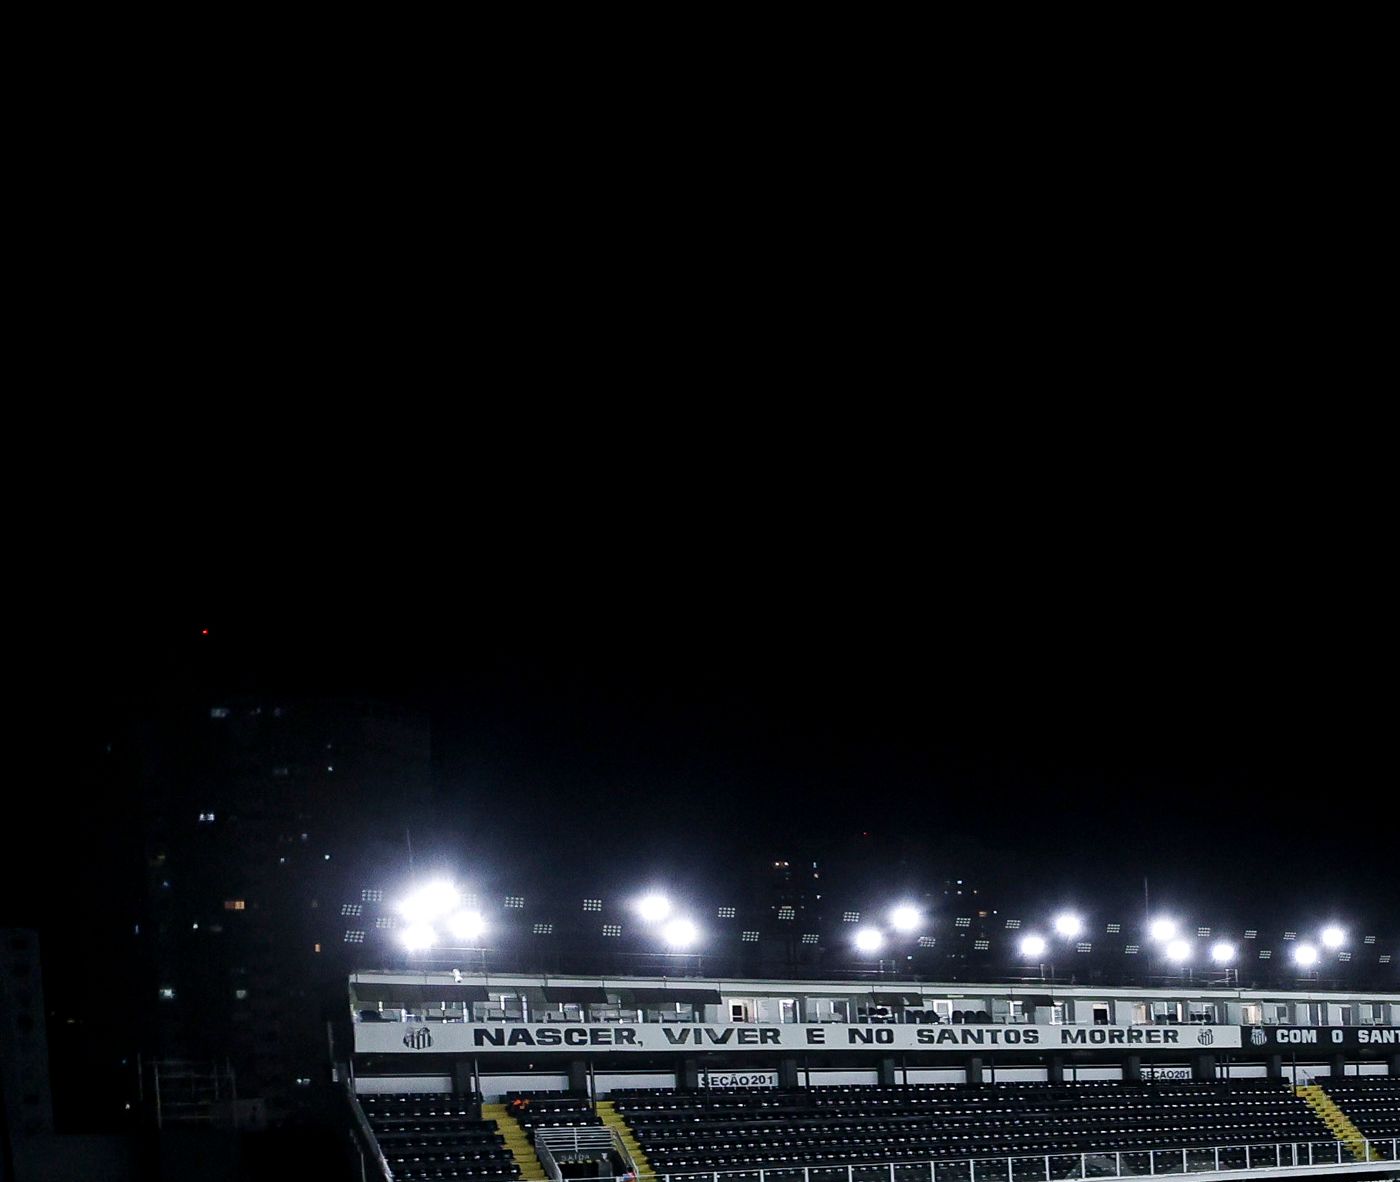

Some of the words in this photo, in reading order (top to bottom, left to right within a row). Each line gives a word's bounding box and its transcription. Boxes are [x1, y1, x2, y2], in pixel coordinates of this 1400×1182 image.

[474, 1028, 643, 1047] NASCER,
[662, 1028, 781, 1045] VIVER
[806, 1028, 825, 1044] E
[848, 1028, 894, 1044] NO
[917, 1028, 1039, 1045] SANTOS
[1061, 1028, 1179, 1044] MORRER
[1276, 1029, 1317, 1044] COM
[1332, 1030, 1343, 1044] O
